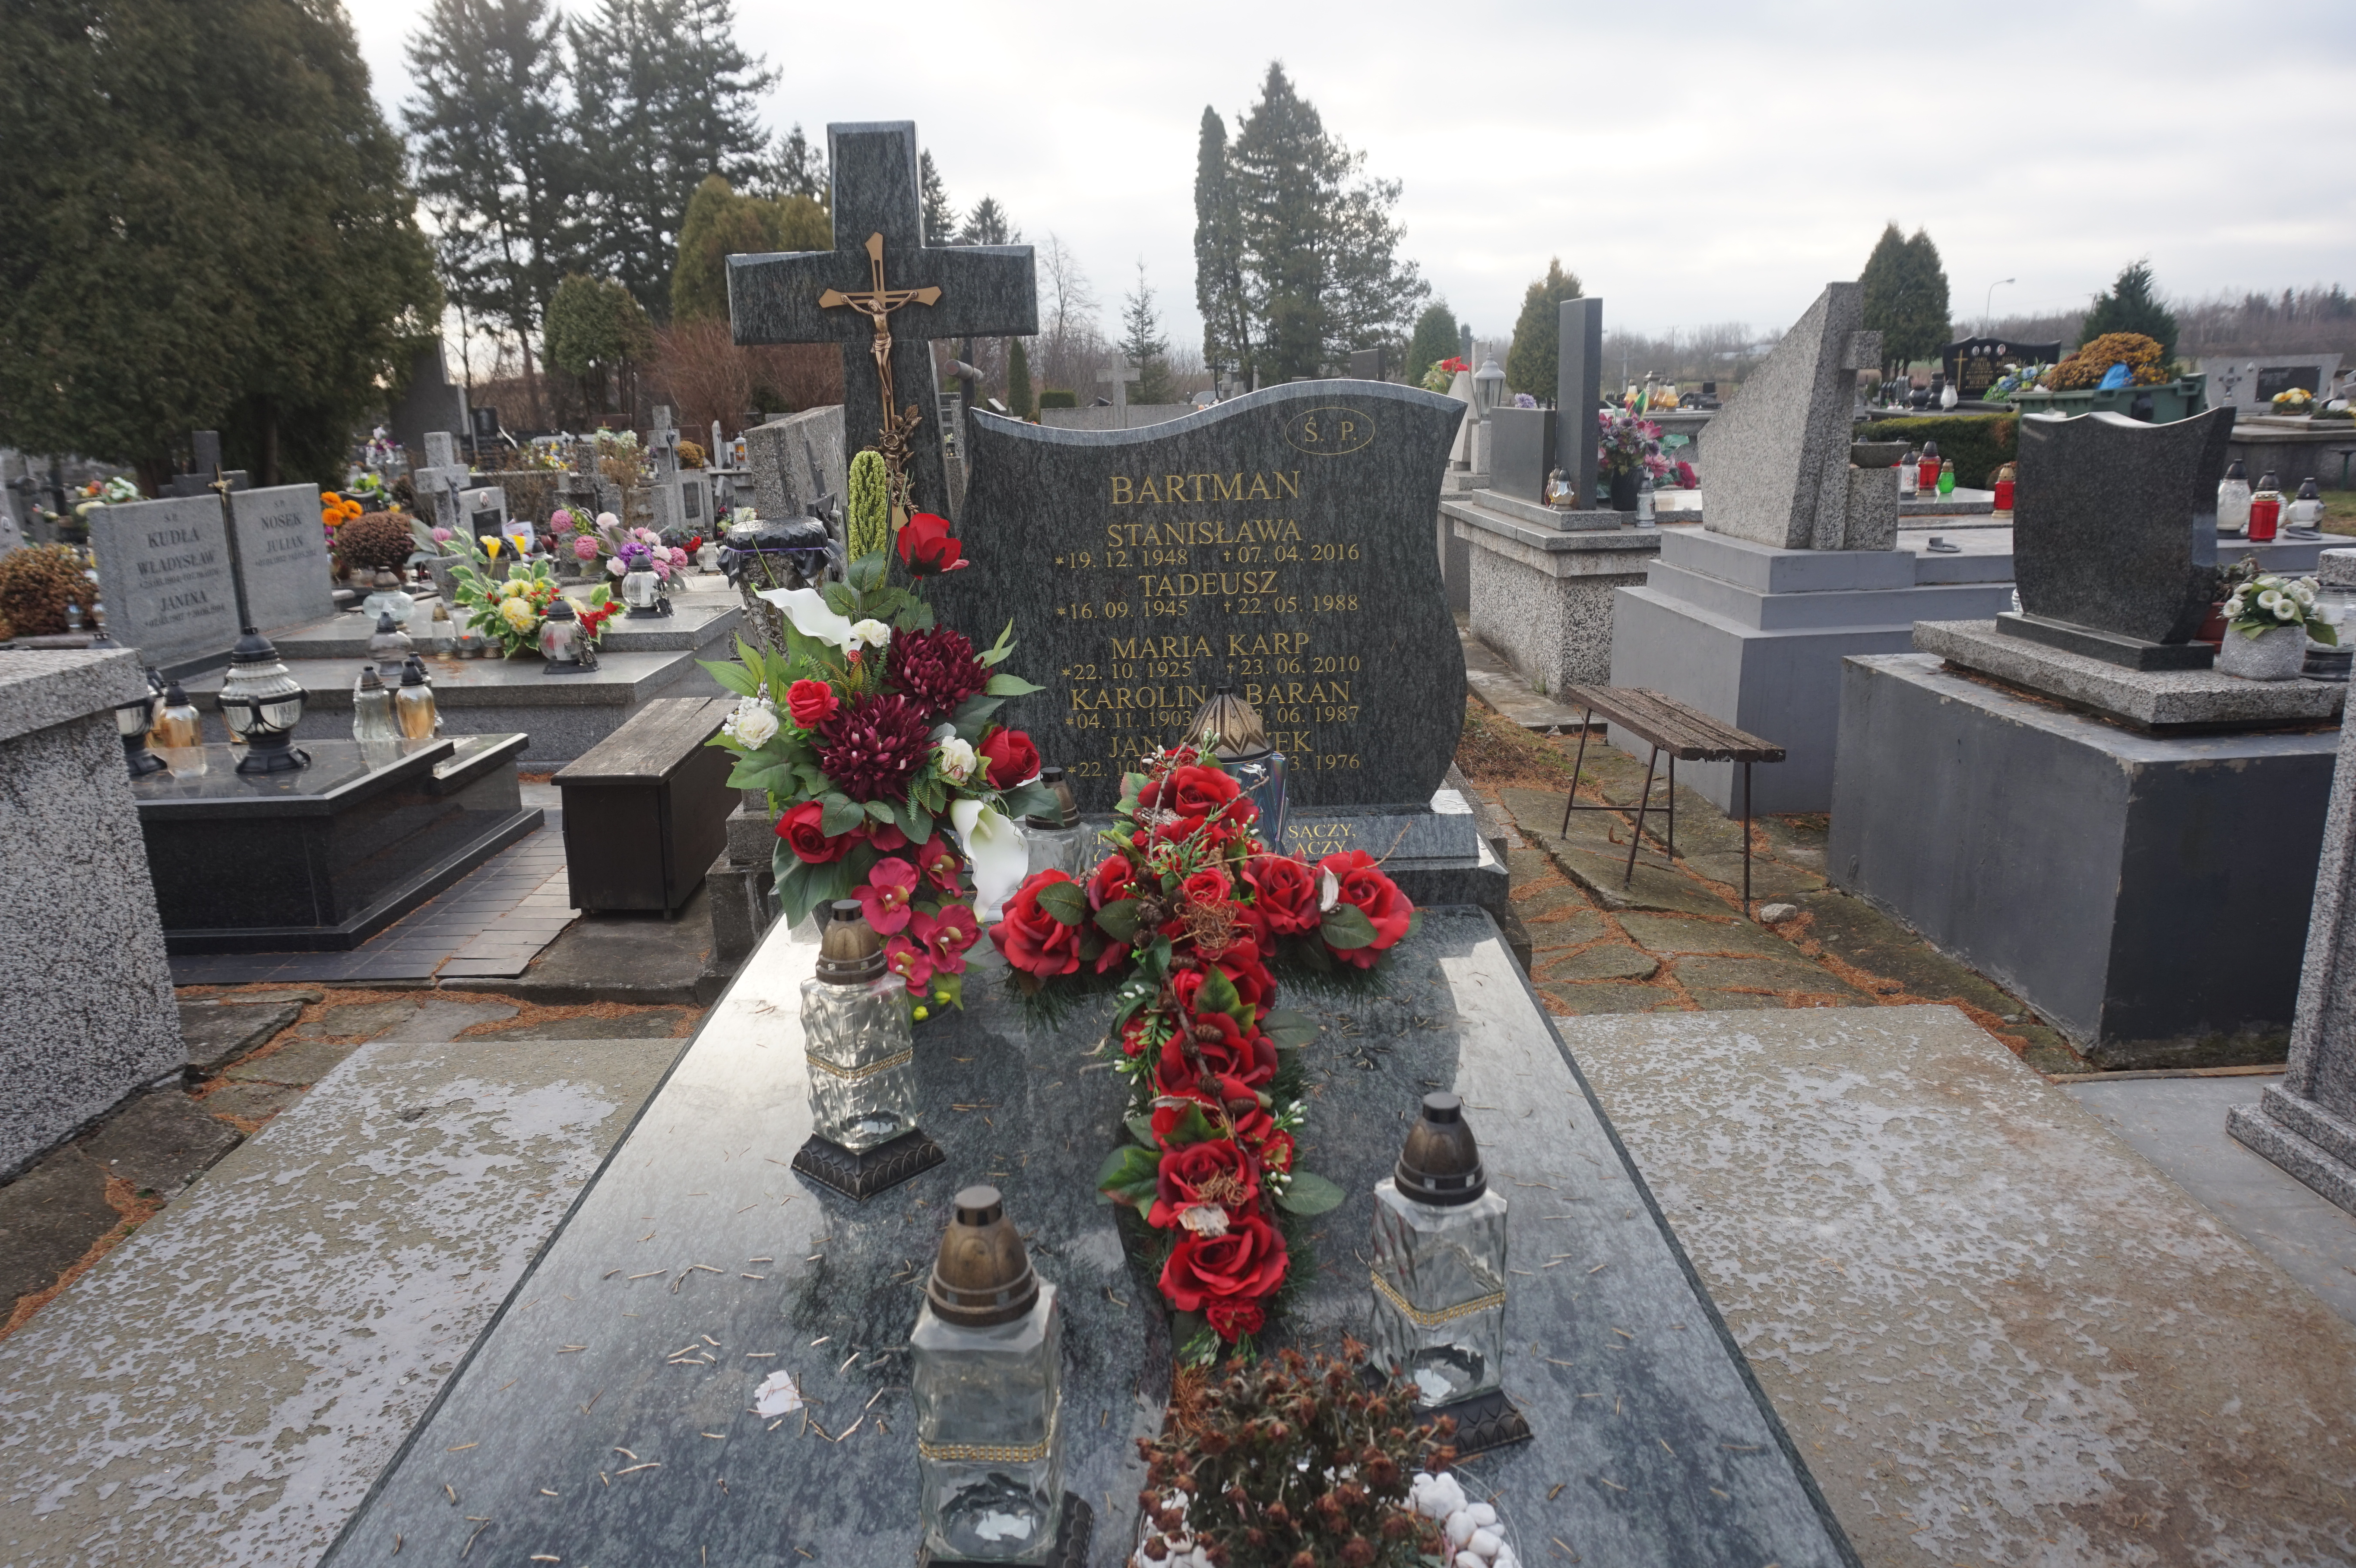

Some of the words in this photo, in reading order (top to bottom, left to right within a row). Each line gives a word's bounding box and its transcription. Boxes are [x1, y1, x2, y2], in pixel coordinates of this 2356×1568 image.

[1304, 416, 1324, 442] Ś.
[1340, 421, 1357, 441] P.
[1110, 471, 1301, 504] BARTMAN
[260, 512, 301, 531] NOSEK
[1107, 519, 1303, 547] STANISŁAWA
[266, 535, 304, 553] JULIAN
[1105, 550, 1133, 567] 12.
[1143, 549, 1188, 566] 1948
[1274, 545, 1304, 562] 04.
[1311, 543, 1359, 561] 2016
[136, 550, 215, 575] WŁADYSŁAW
[1138, 571, 1278, 597] TADEUSZ
[161, 590, 207, 612] JANINA
[1105, 601, 1134, 618] 09.
[1144, 600, 1188, 617] 1945
[1274, 596, 1303, 613] 05.
[1313, 594, 1358, 612] 1988
[1110, 635, 1213, 659] MARIA
[1227, 632, 1310, 656] KARP
[1112, 663, 1138, 679] 10.
[1148, 661, 1192, 678] 1925
[1276, 658, 1306, 674] 06.
[1313, 655, 1360, 673] 2010
[1071, 685, 1216, 710] KAROLIN
[1244, 681, 1351, 705] BARAN
[1115, 712, 1140, 728] 11.
[1150, 711, 1193, 727] 1903
[1277, 707, 1306, 723] 06.
[1315, 705, 1359, 722] 1987
[1108, 735, 1163, 758] JAN
[1316, 754, 1360, 771] 1976
[1289, 823, 1356, 840] SĄCZY,
